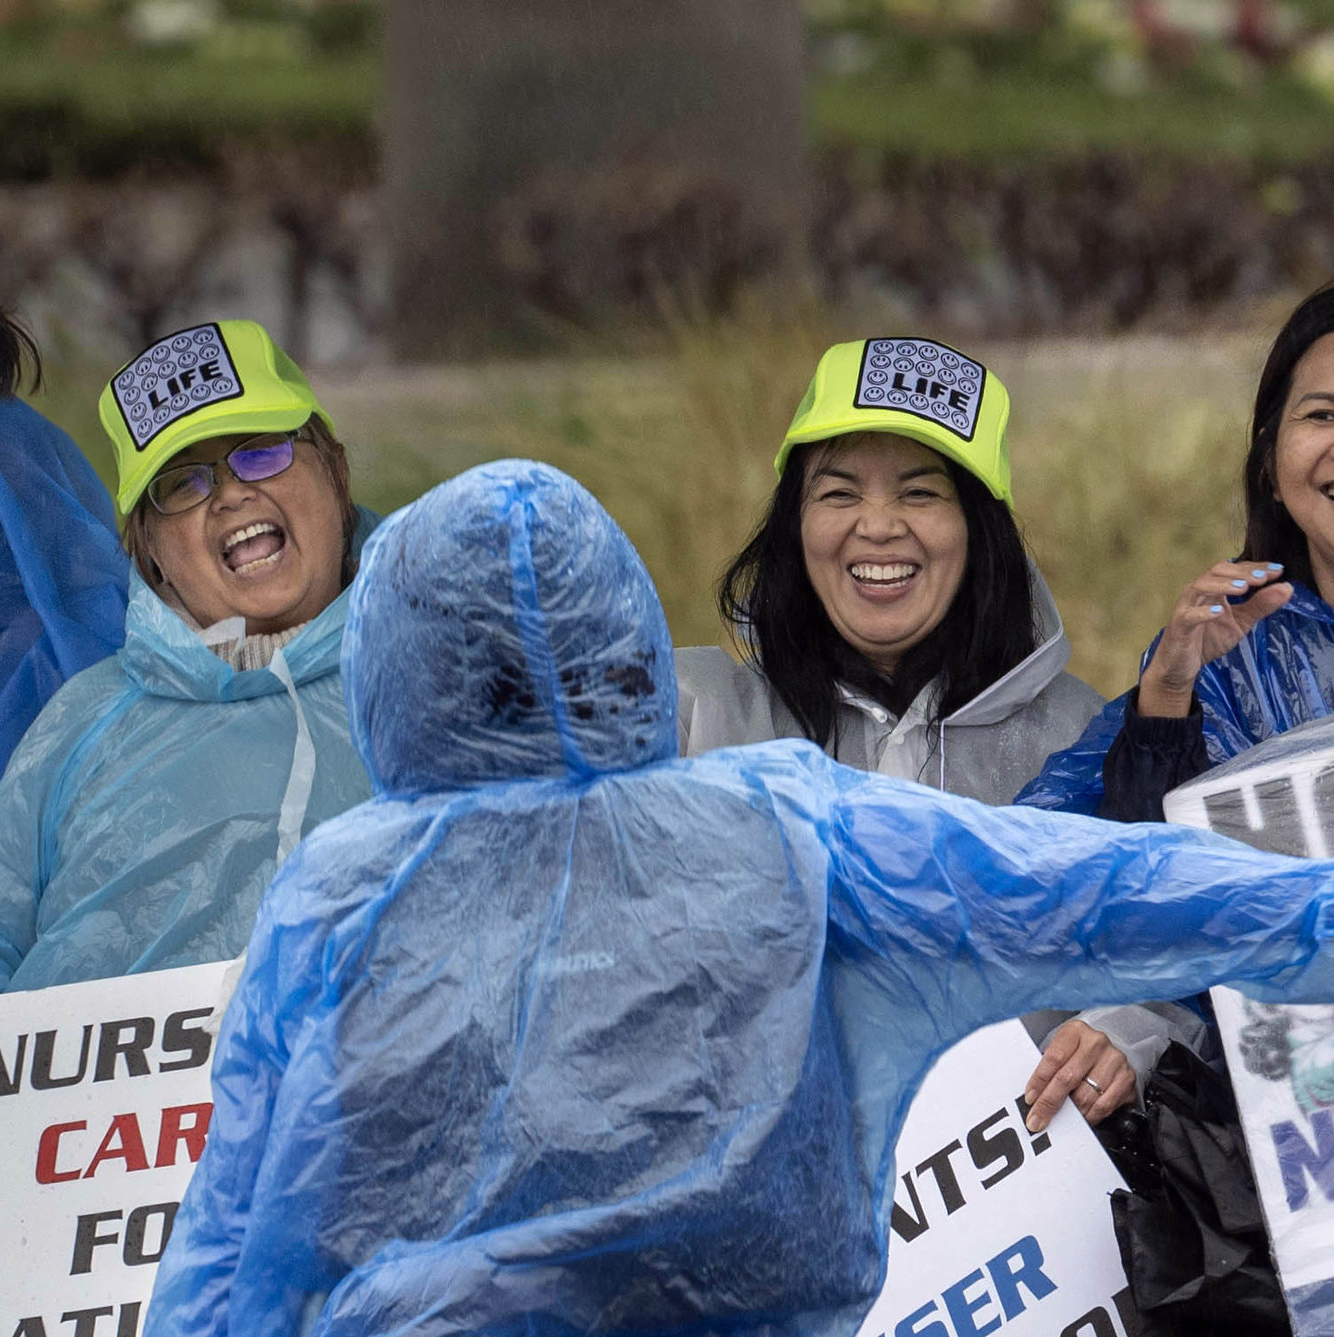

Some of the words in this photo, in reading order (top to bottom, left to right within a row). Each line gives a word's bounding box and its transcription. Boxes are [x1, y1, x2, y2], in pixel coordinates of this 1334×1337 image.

[148, 361, 222, 410] LIFE
[892, 373, 970, 413] LIFE
[69, 1202, 181, 1276] FO
